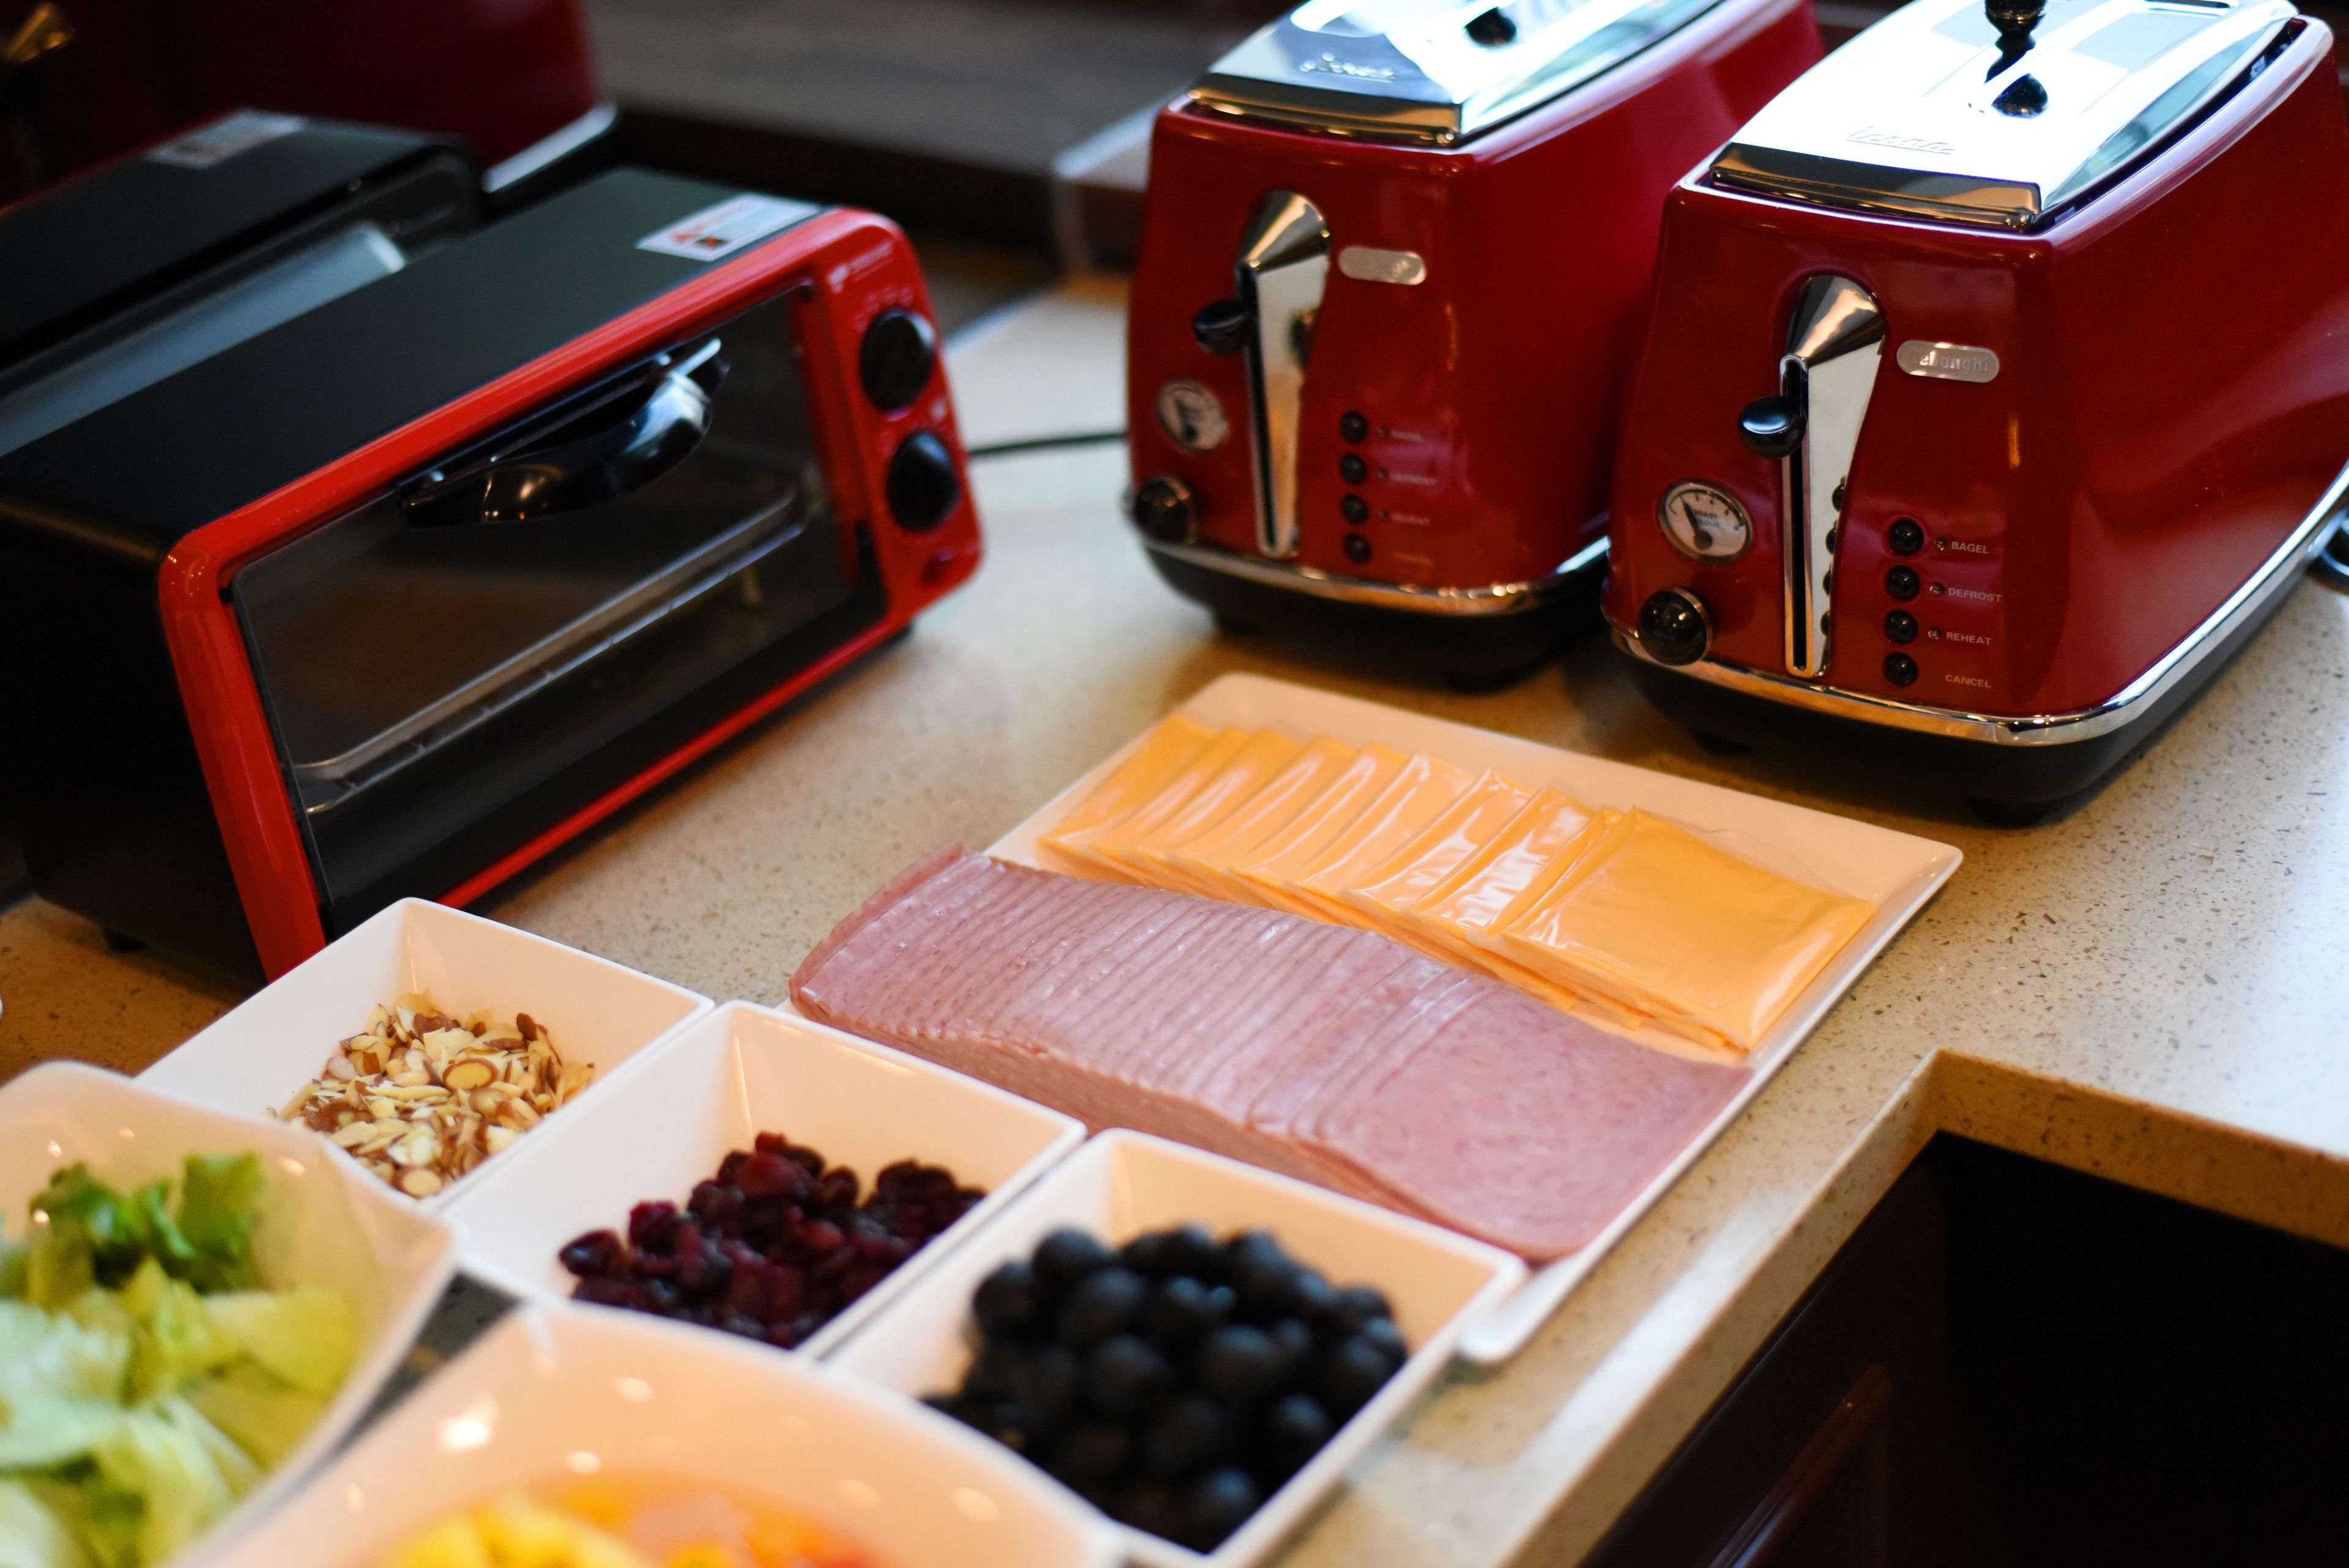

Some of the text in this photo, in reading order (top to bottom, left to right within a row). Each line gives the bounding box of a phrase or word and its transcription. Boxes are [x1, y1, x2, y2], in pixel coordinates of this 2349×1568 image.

[1951, 541, 1989, 554] BAGEL
[1948, 588, 2002, 603] DEFROST
[1946, 632, 1992, 645] REHEAT
[1945, 675, 1991, 688] CANCEL
